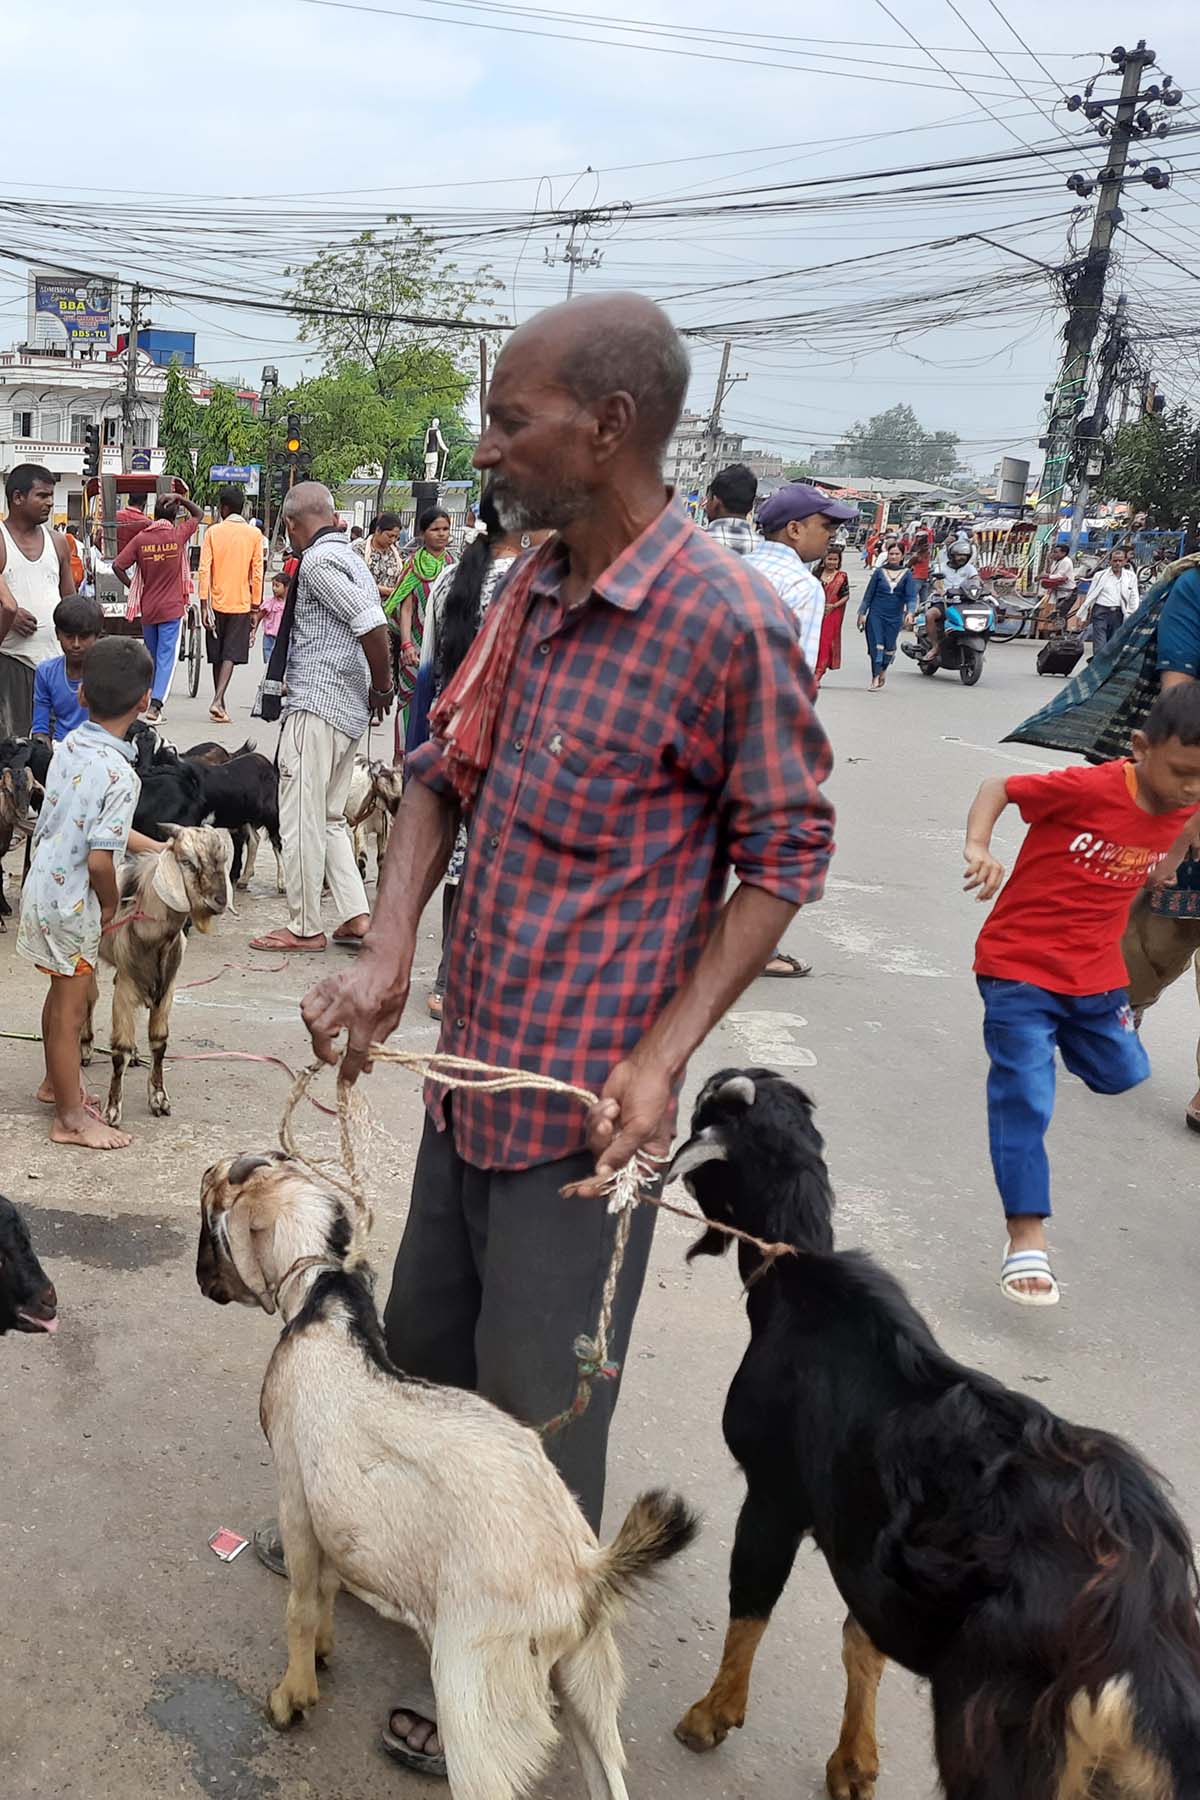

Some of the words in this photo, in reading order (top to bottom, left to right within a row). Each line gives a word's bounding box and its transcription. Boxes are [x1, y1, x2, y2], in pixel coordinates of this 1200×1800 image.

[59, 301, 86, 310] BBA
[141, 545, 156, 553] TAKE
[162, 543, 178, 552] LEAD
